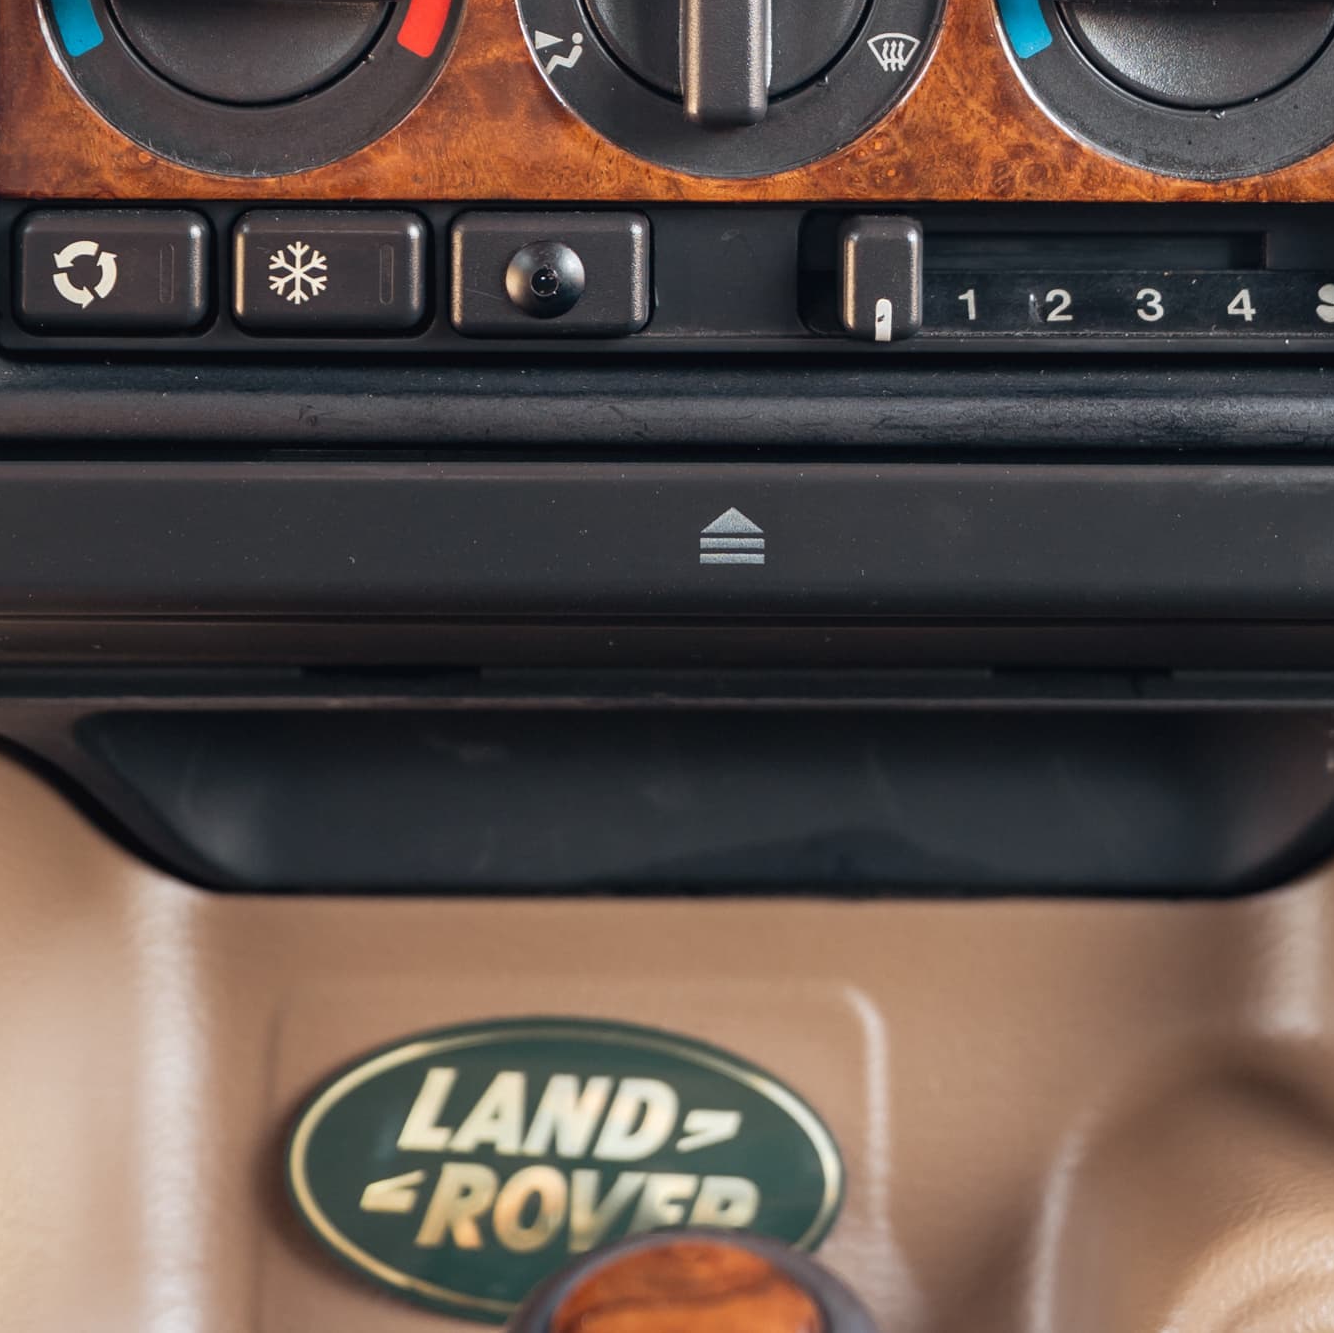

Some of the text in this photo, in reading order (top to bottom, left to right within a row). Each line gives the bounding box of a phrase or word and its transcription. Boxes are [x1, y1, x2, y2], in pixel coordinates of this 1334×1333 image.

[958, 289, 1257, 322] 1 2 3 4
[397, 1067, 679, 1162] LAND
